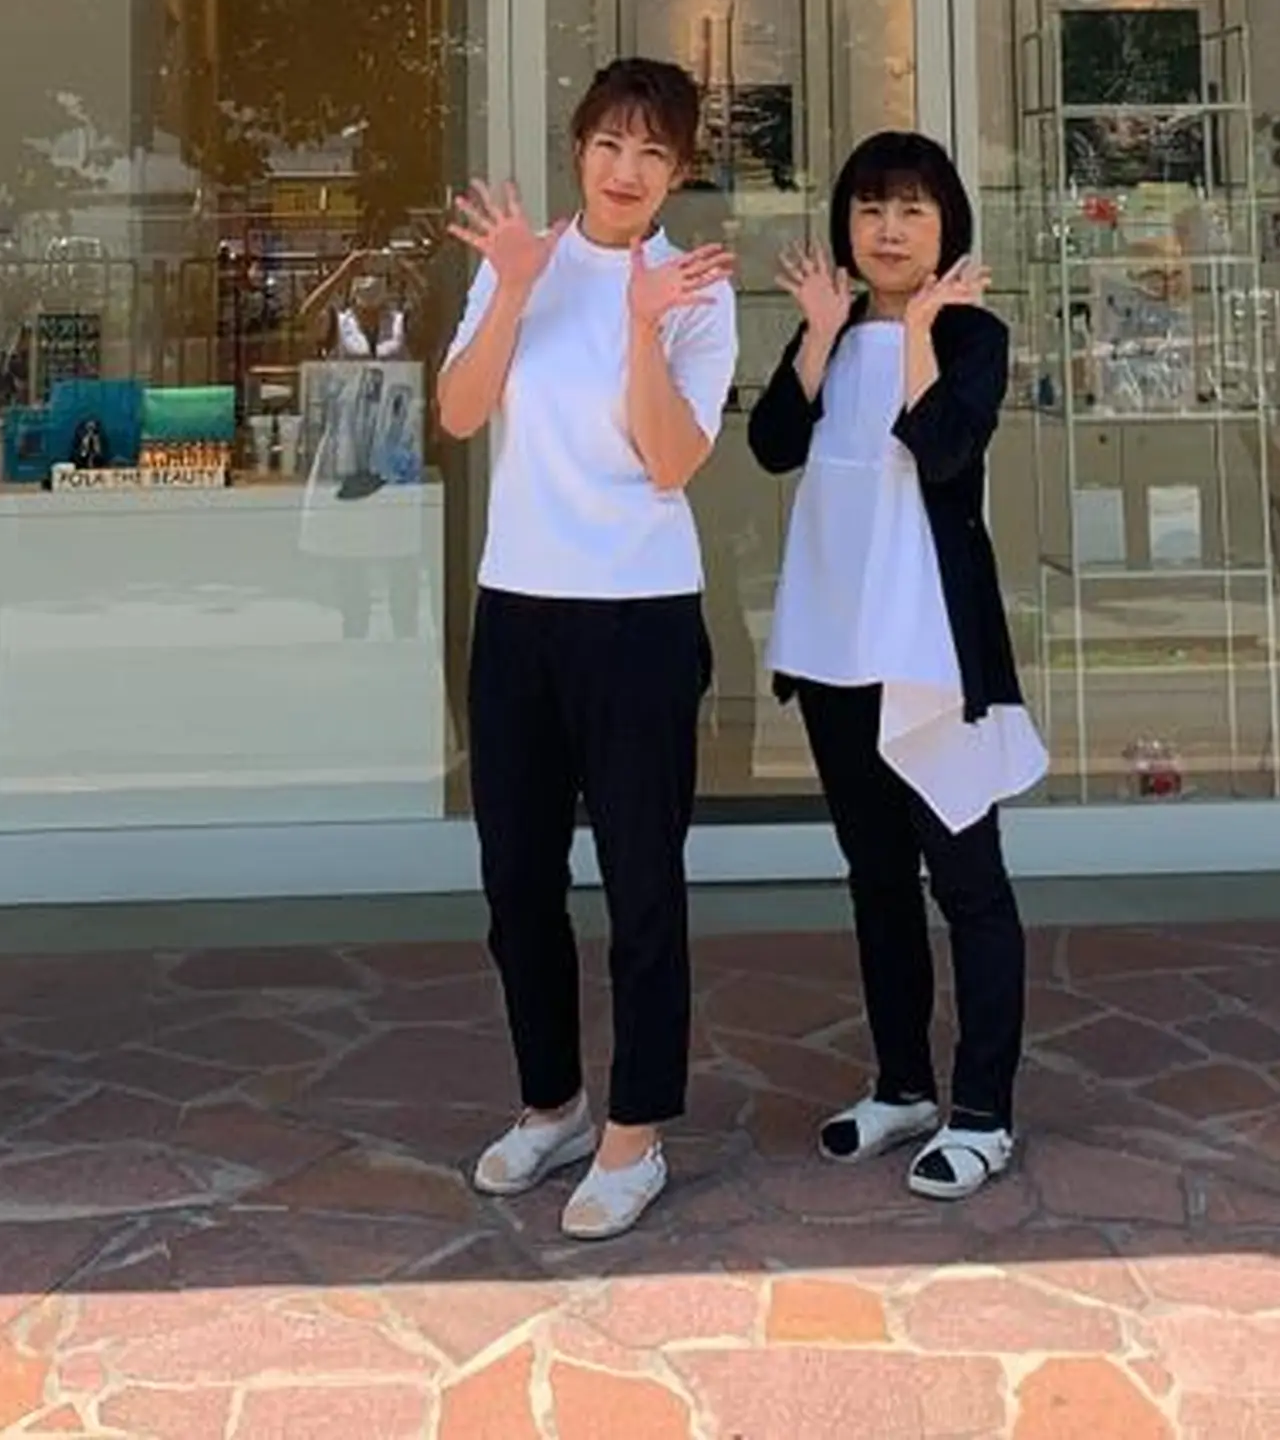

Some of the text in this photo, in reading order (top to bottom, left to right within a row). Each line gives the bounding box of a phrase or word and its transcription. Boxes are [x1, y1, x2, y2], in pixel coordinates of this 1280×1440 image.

[59, 468, 215, 487] POLA THE BEAUTY
